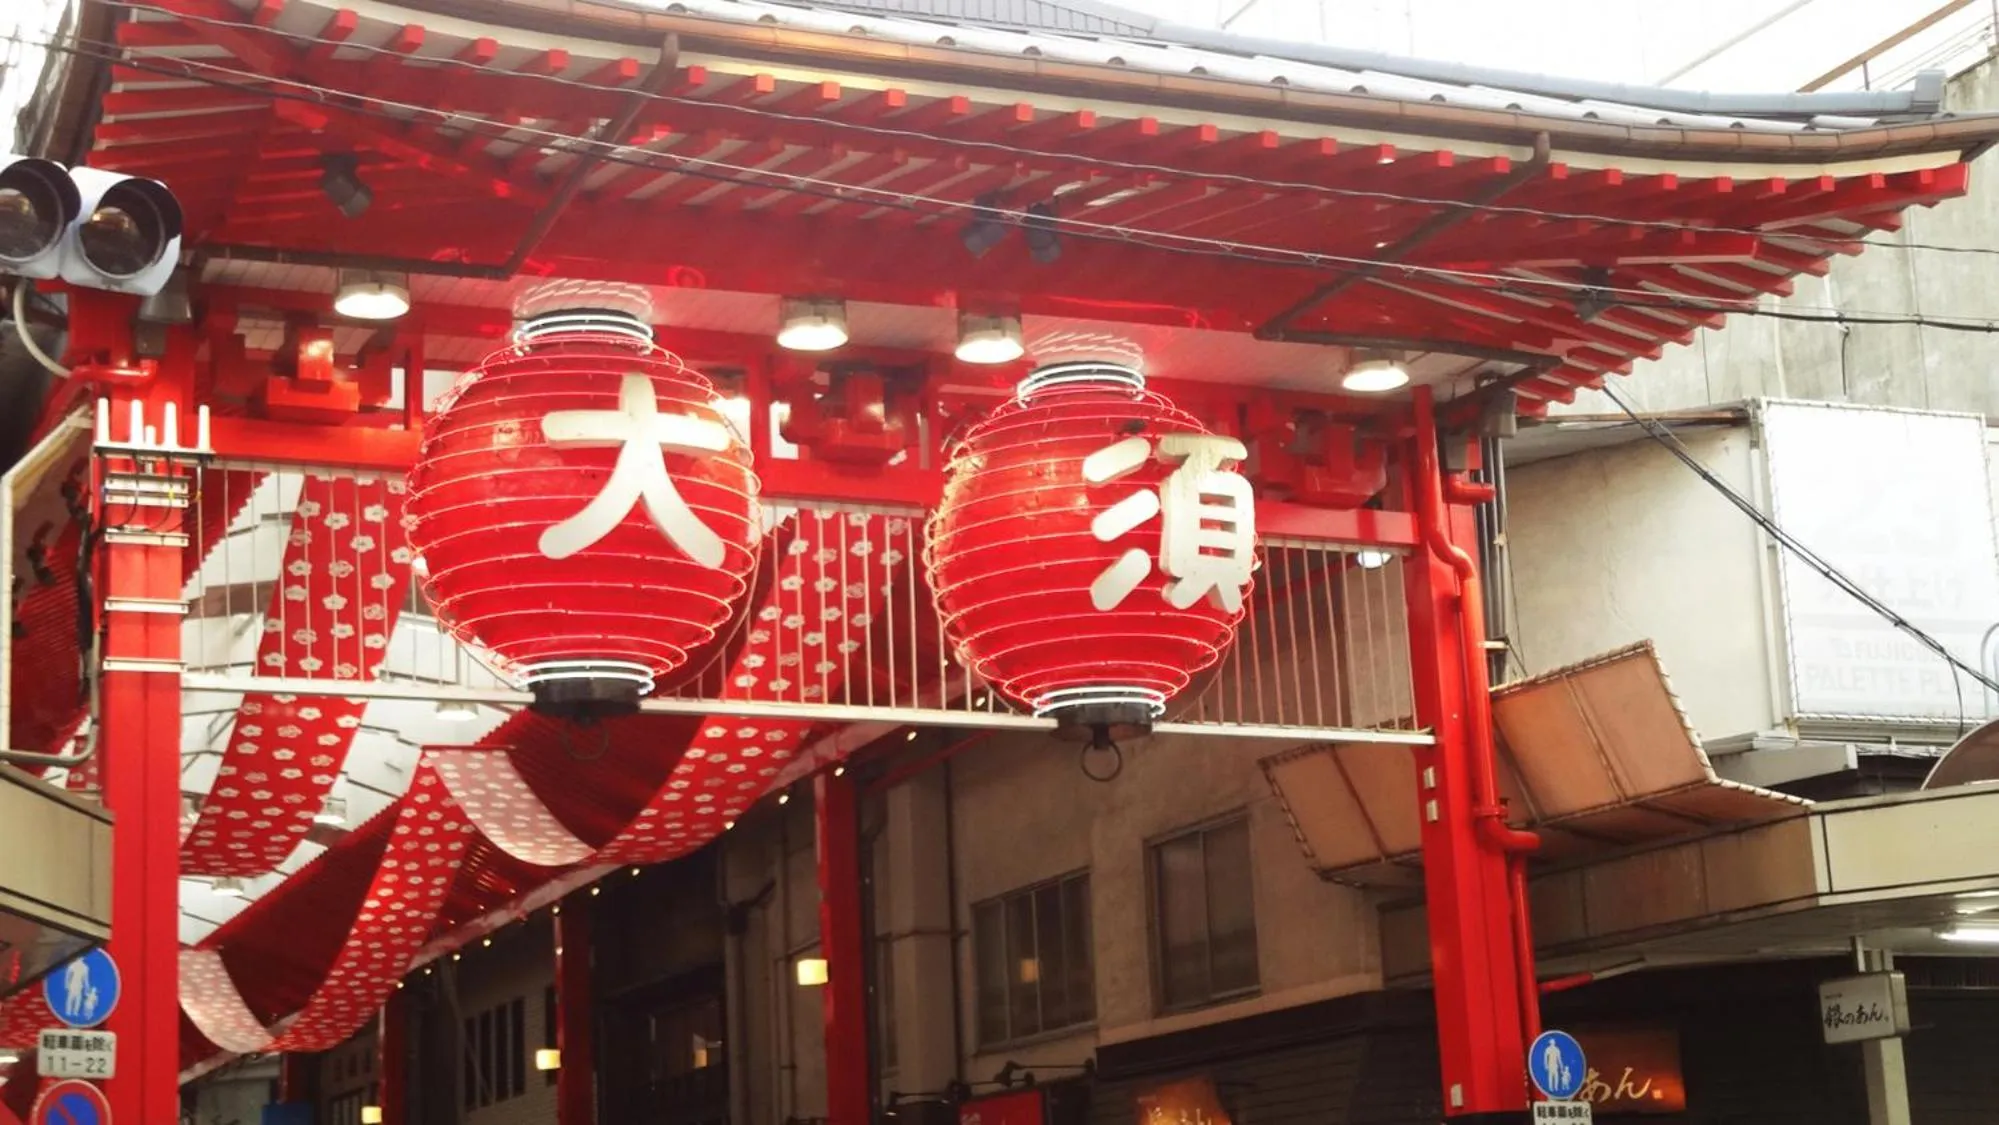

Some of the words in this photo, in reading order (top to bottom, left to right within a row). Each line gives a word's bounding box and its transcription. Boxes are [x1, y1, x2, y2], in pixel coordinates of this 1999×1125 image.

[539, 373, 734, 569] 大
[1083, 435, 1256, 613] 須
[1804, 663, 1909, 693] PALETTE
[47, 1056, 107, 1073] 11-22
